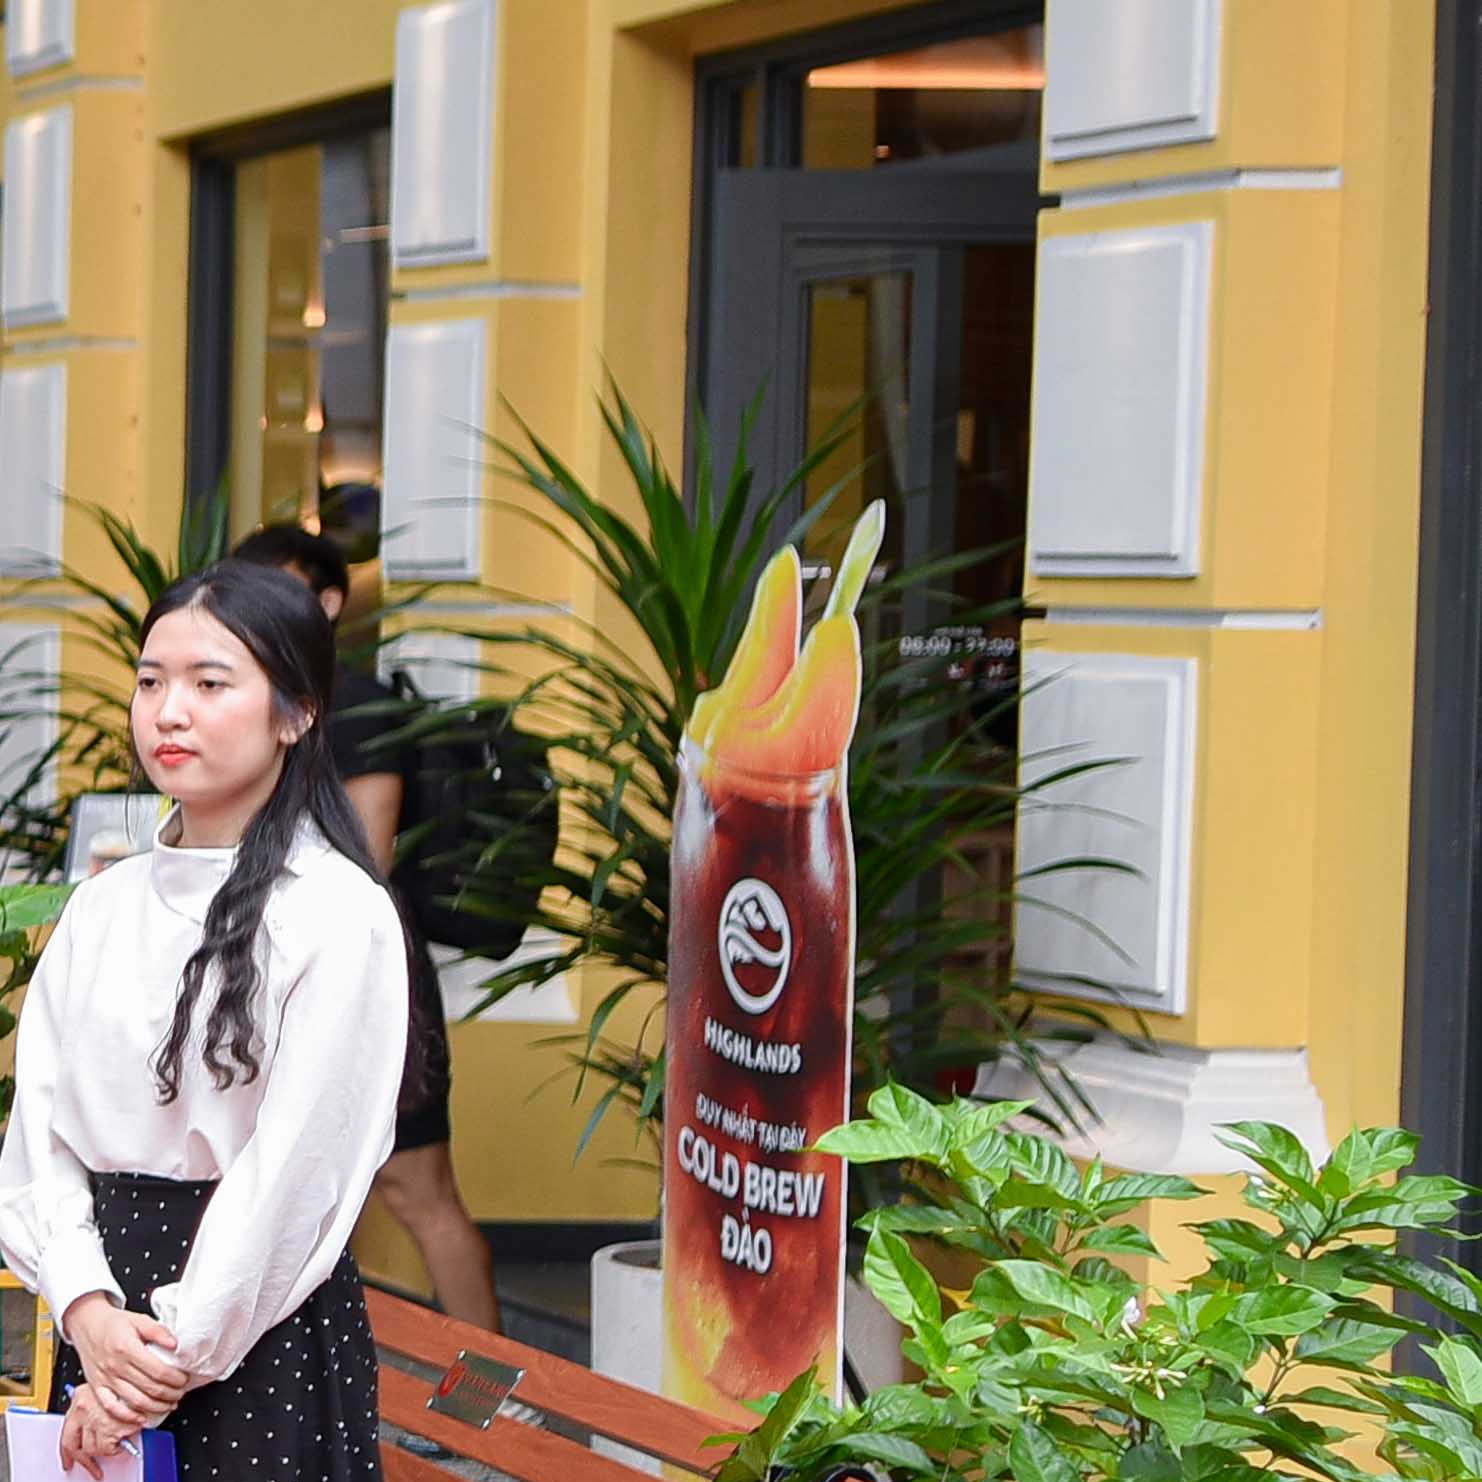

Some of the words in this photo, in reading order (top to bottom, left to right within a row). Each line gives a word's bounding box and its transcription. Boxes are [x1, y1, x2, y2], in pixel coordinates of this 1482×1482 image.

[703, 1016, 802, 1075] HIGHLANDS
[678, 1126, 740, 1200] COLD
[743, 1160, 825, 1219] BREW
[720, 1205, 773, 1275] ĐÀO
